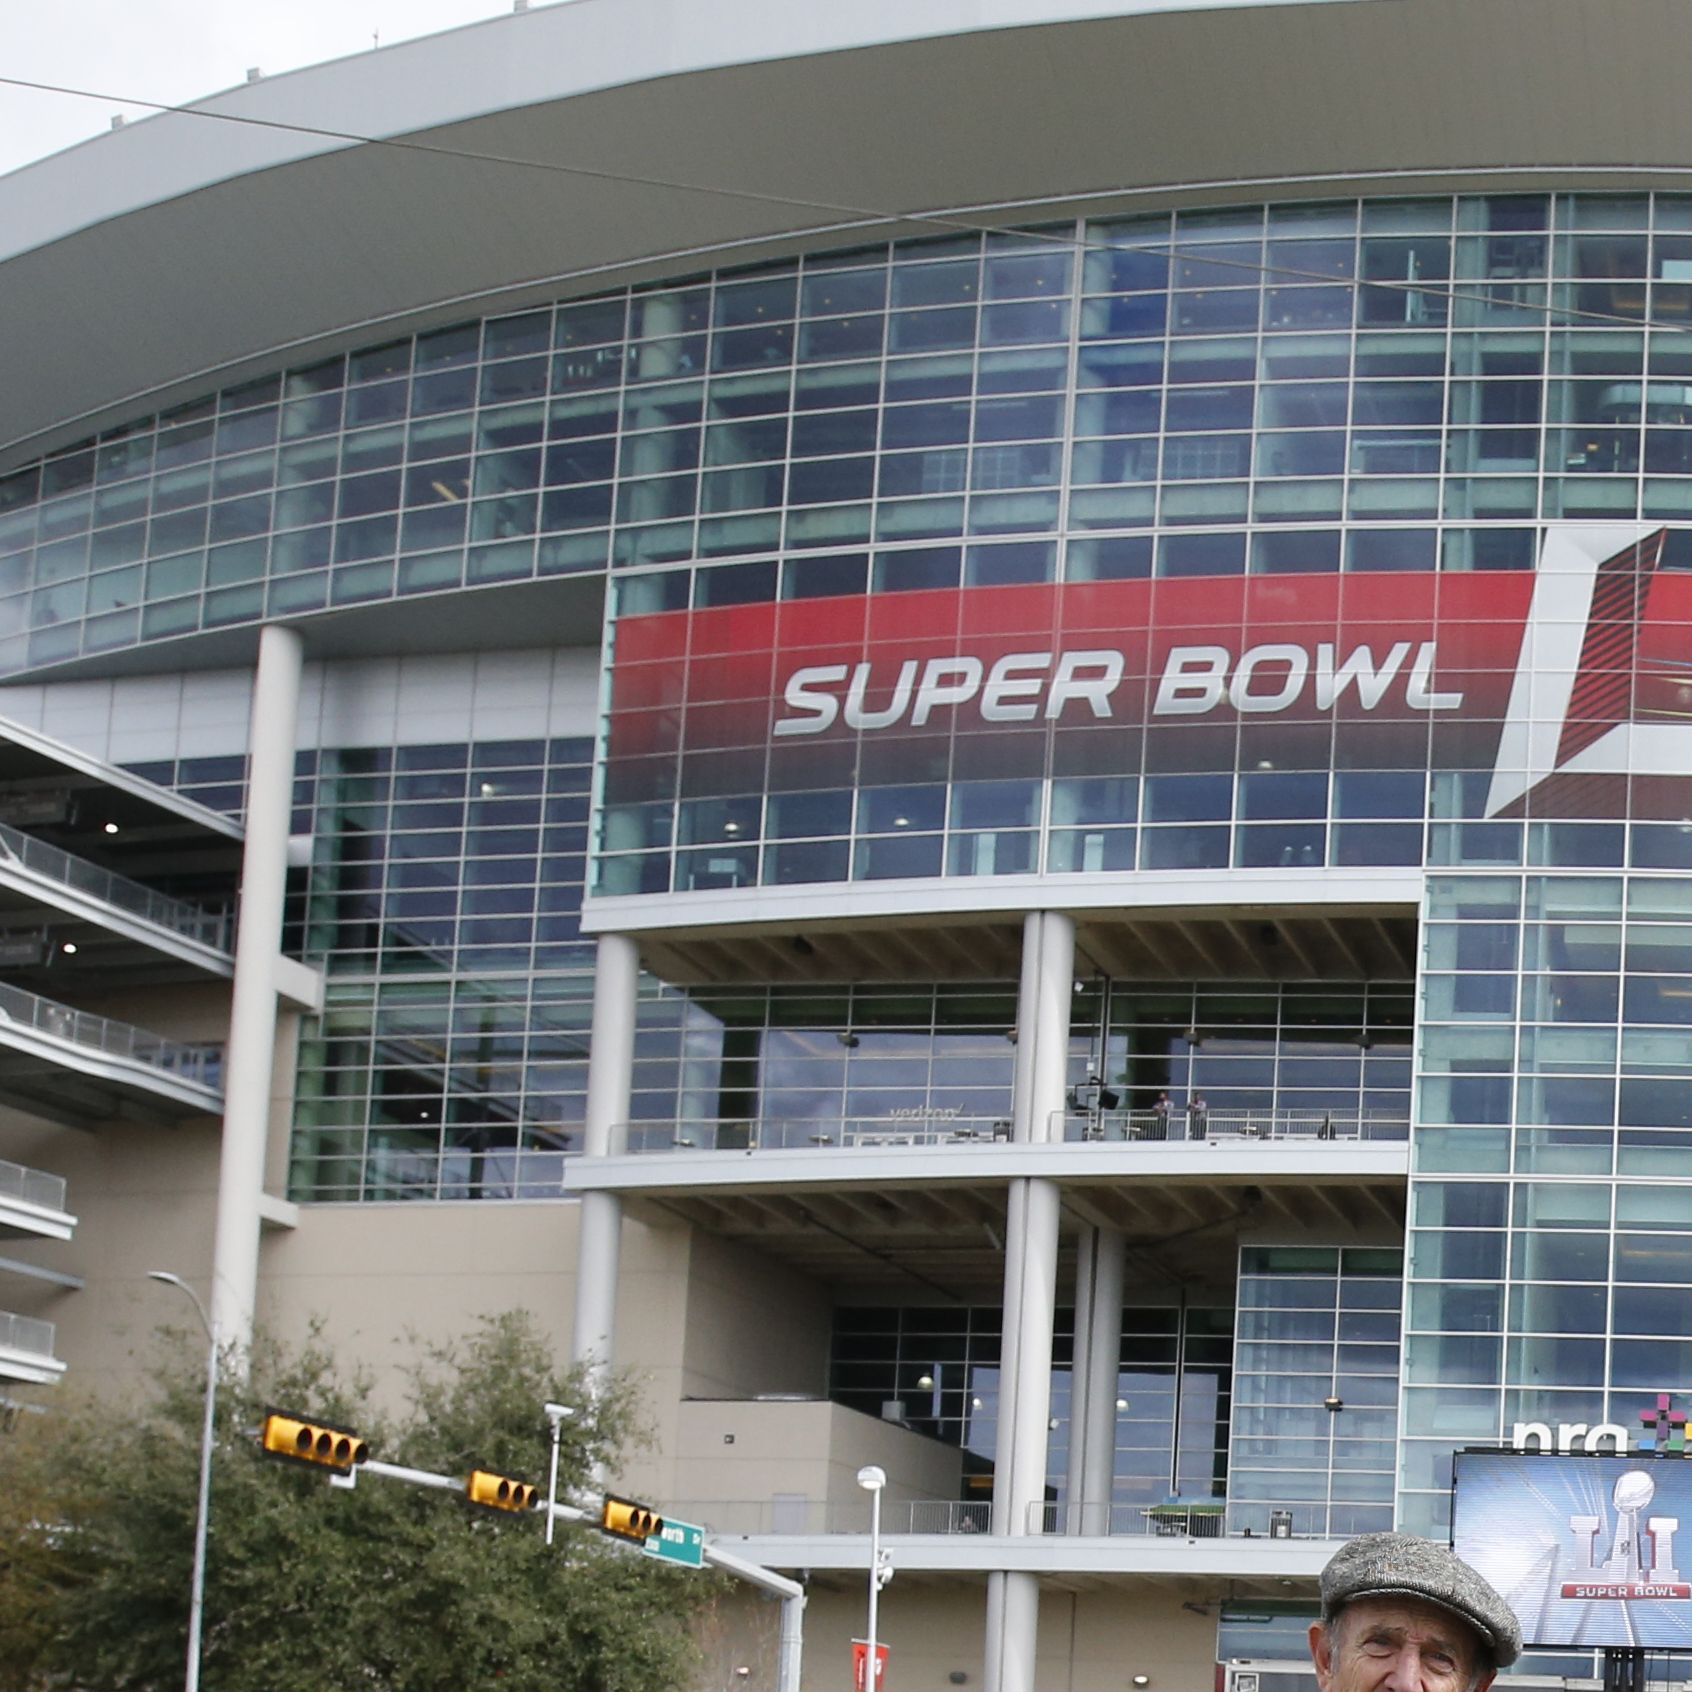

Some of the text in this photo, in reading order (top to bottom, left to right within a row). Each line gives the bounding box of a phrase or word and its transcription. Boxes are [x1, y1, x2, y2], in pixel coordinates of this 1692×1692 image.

[773, 649, 1126, 737] SUPER
[1152, 639, 1465, 716] BOWL
[889, 1104, 956, 1121] verizon
[1575, 1586, 1678, 1597] SUPER BOWL
